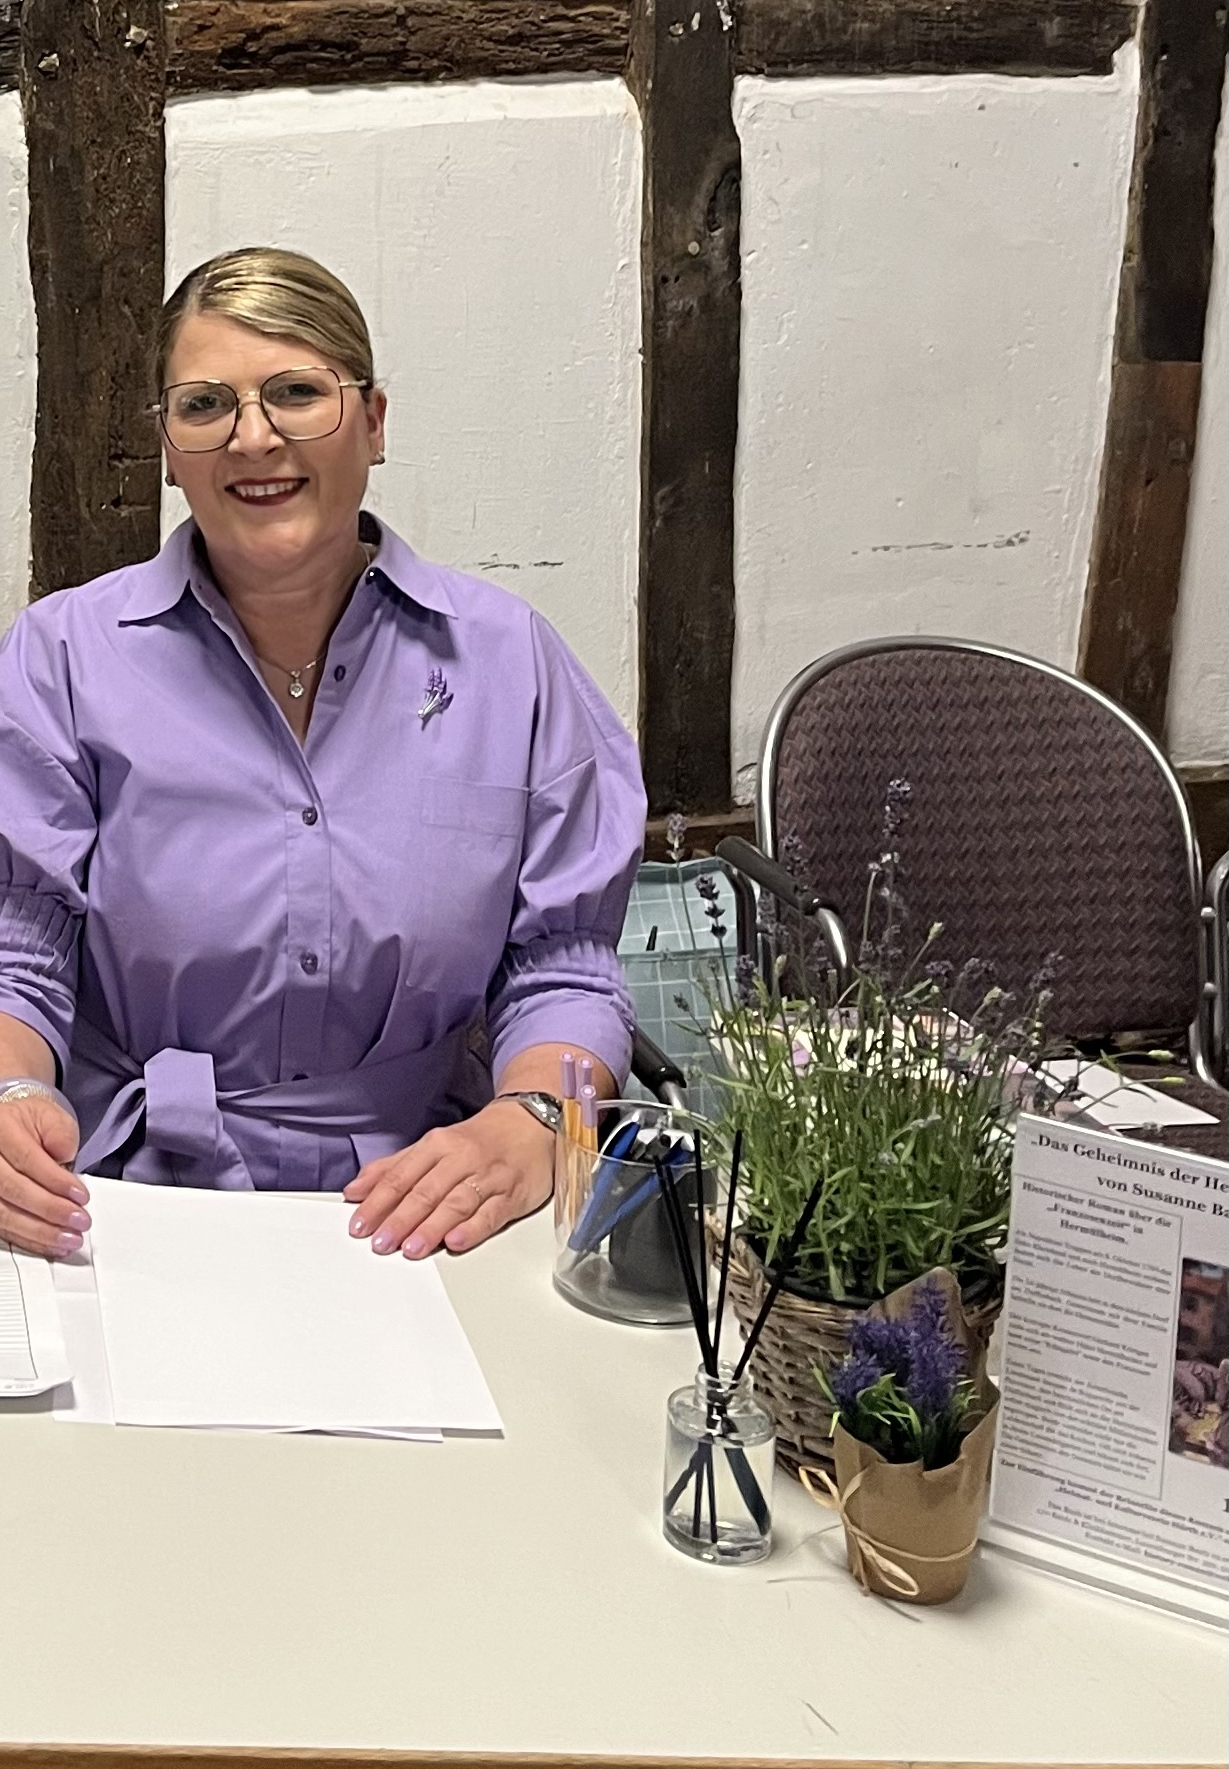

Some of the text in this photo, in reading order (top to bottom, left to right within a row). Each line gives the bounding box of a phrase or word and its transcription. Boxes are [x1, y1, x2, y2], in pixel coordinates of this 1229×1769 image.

[1073, 1143, 1166, 1177] Geheimnis
[1170, 1167, 1201, 1185] der
[1097, 1176, 1128, 1193] von
[1132, 1183, 1208, 1213] Susanne
